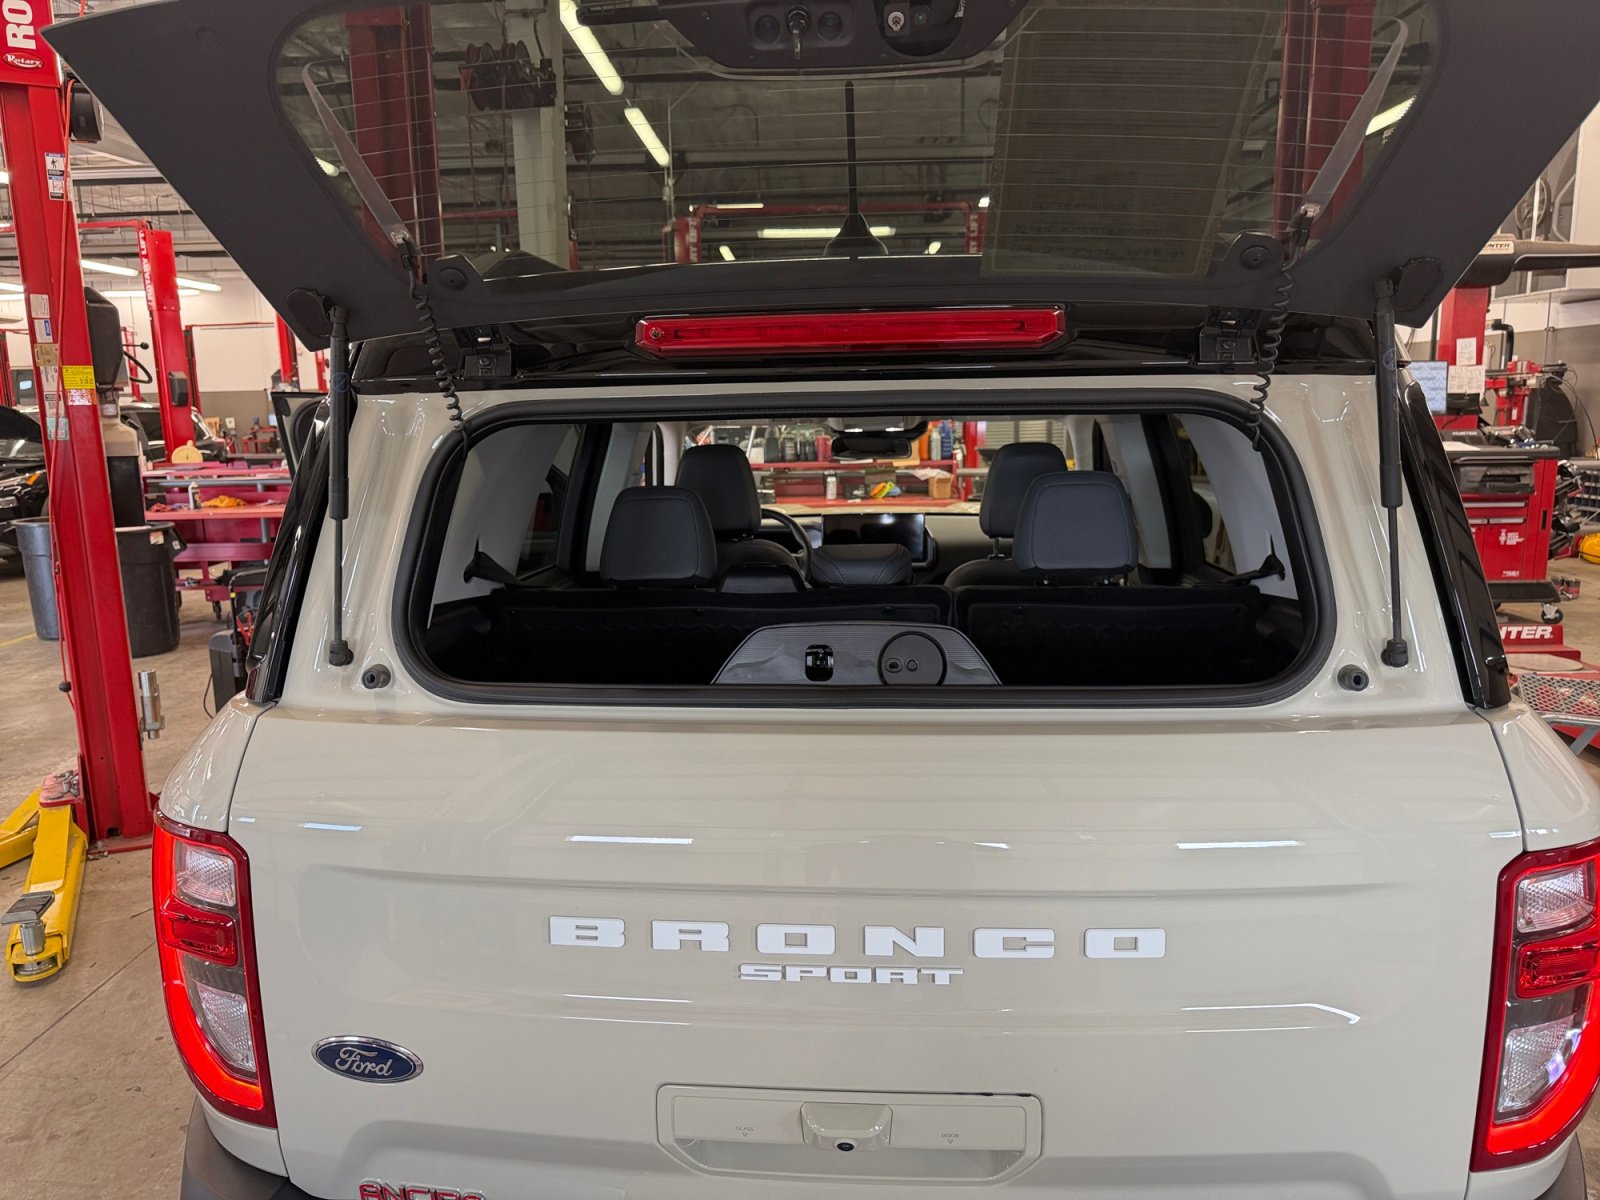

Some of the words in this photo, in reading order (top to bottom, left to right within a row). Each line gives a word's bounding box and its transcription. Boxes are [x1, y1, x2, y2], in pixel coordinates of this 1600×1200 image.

[4, 53, 42, 68] Rotary
[1499, 625, 1553, 640] NTER
[549, 915, 1167, 959] BRONCO
[738, 962, 964, 985] SPORT
[335, 1046, 393, 1077] Ford
